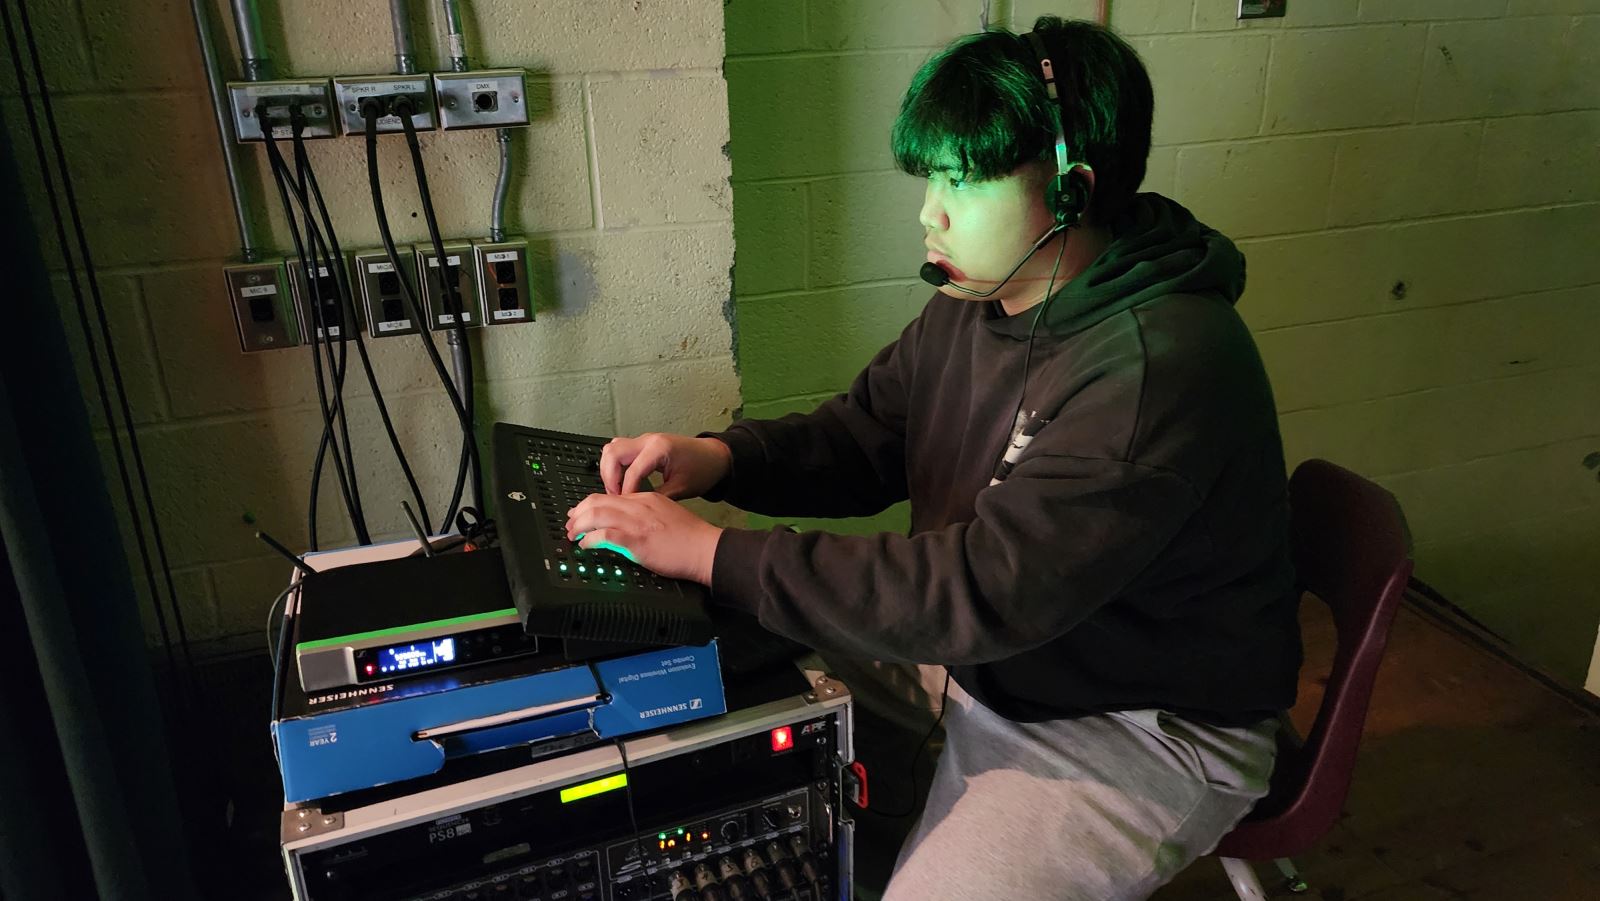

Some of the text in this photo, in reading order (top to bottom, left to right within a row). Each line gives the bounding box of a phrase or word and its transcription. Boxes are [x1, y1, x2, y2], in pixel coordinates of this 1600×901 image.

[660, 658, 673, 667] Set
[618, 673, 640, 684] Digital
[308, 684, 394, 705] SENNHEISER
[639, 702, 688, 719] SENNHEISER
[309, 737, 329, 747] YEAR
[329, 732, 338, 743] 2
[429, 827, 455, 844] PS8
